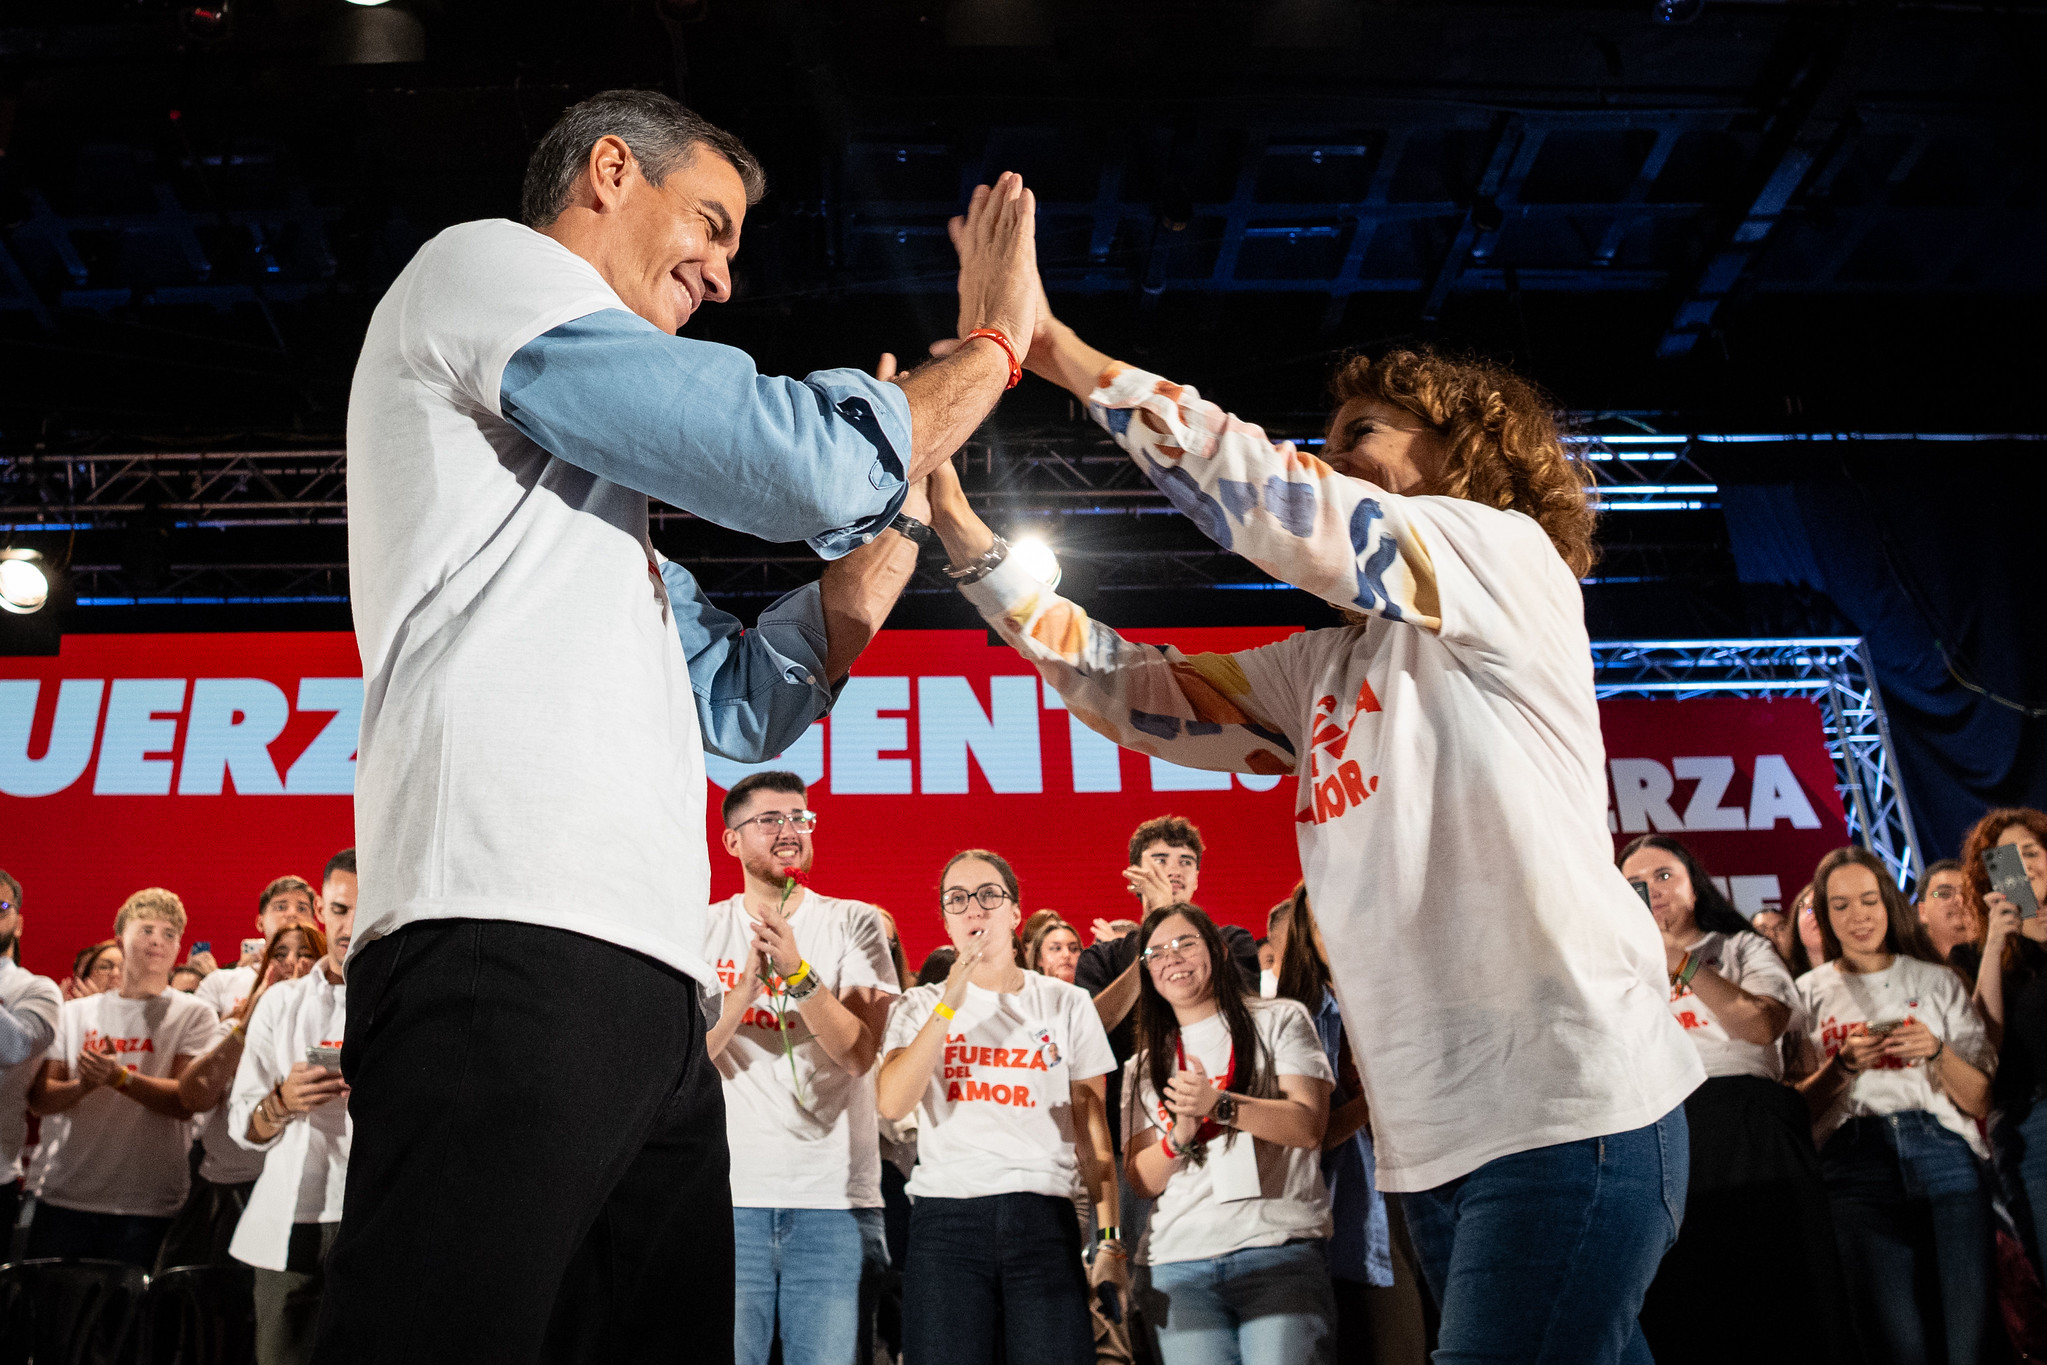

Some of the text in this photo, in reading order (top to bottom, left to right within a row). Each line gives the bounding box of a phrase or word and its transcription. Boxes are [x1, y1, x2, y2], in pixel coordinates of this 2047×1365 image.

[1608, 754, 1822, 834] RZA
[716, 958, 735, 969] LA
[946, 1033, 966, 1044] LA
[944, 1046, 1048, 1072] FUERZA
[944, 1066, 972, 1079] DEL
[946, 1081, 1036, 1108] AMOR.
